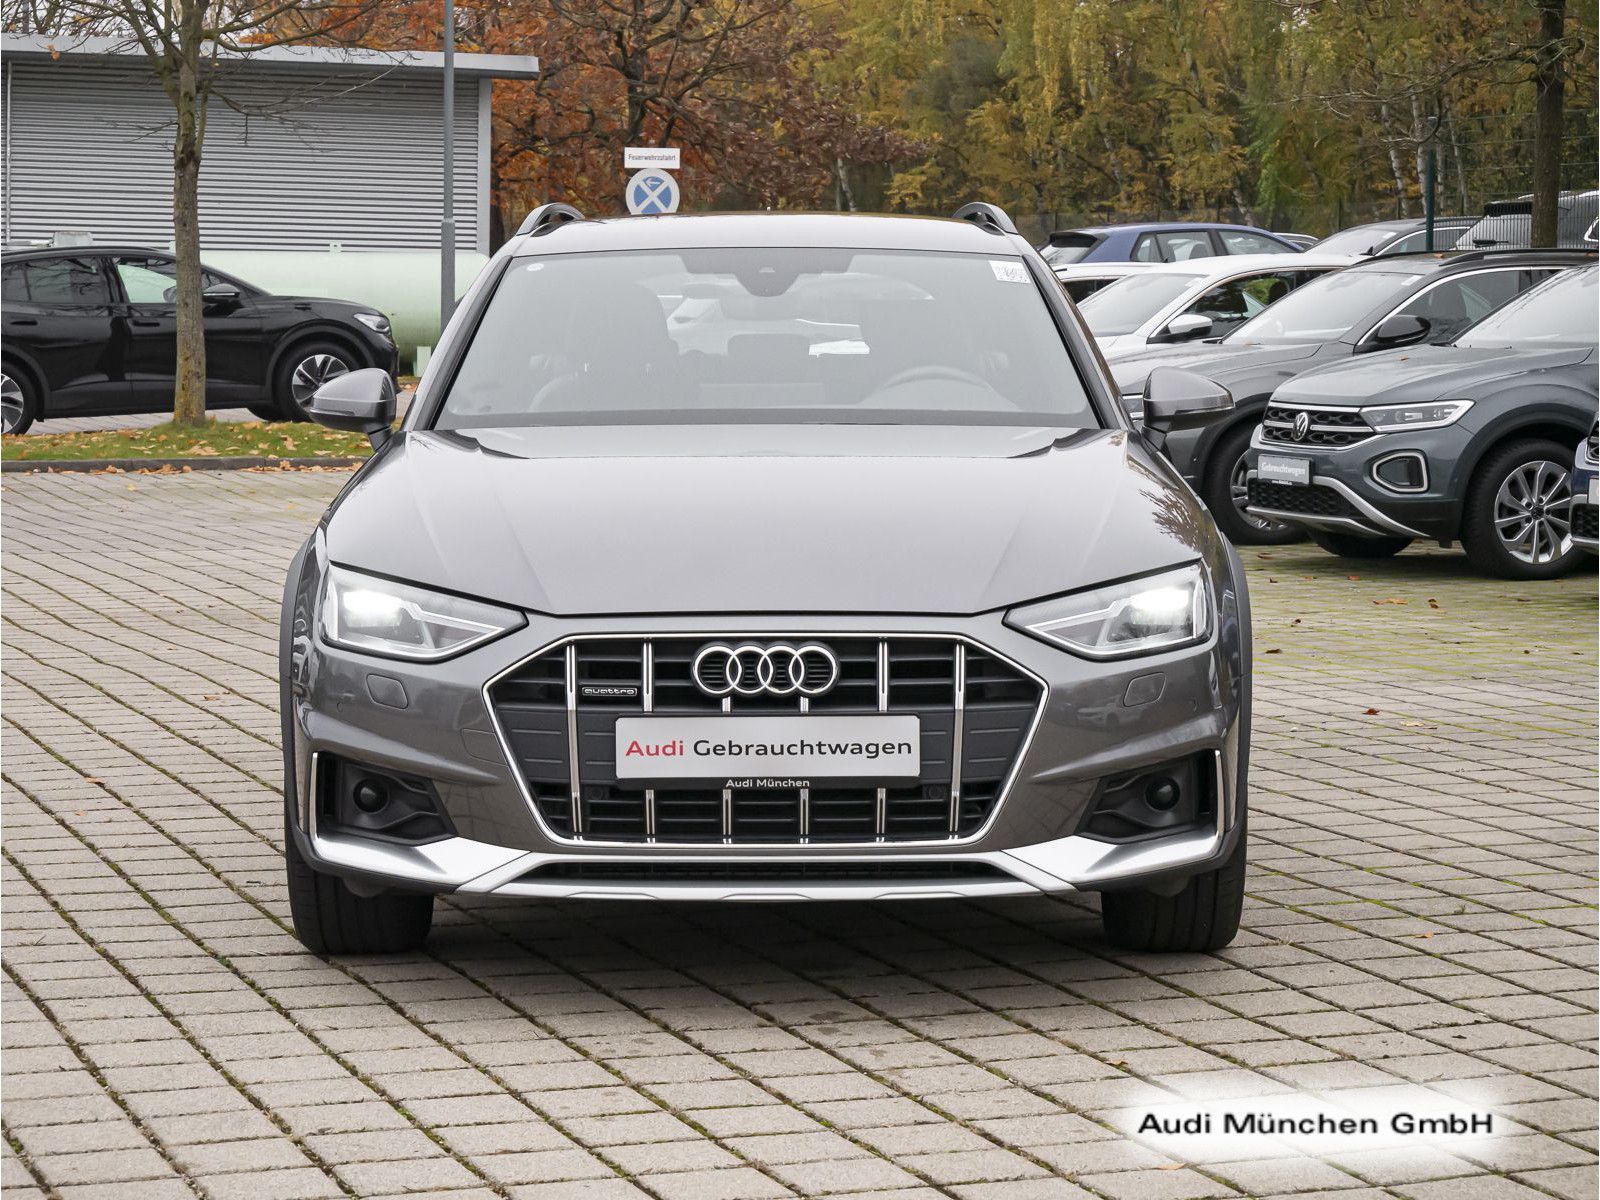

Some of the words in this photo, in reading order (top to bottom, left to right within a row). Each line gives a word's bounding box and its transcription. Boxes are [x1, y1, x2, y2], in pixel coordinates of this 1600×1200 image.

[584, 688, 635, 696] quattro
[625, 740, 685, 757] Audi
[693, 739, 912, 758] Gebrauchtwagen
[725, 779, 754, 788] Audi
[757, 778, 811, 788] München
